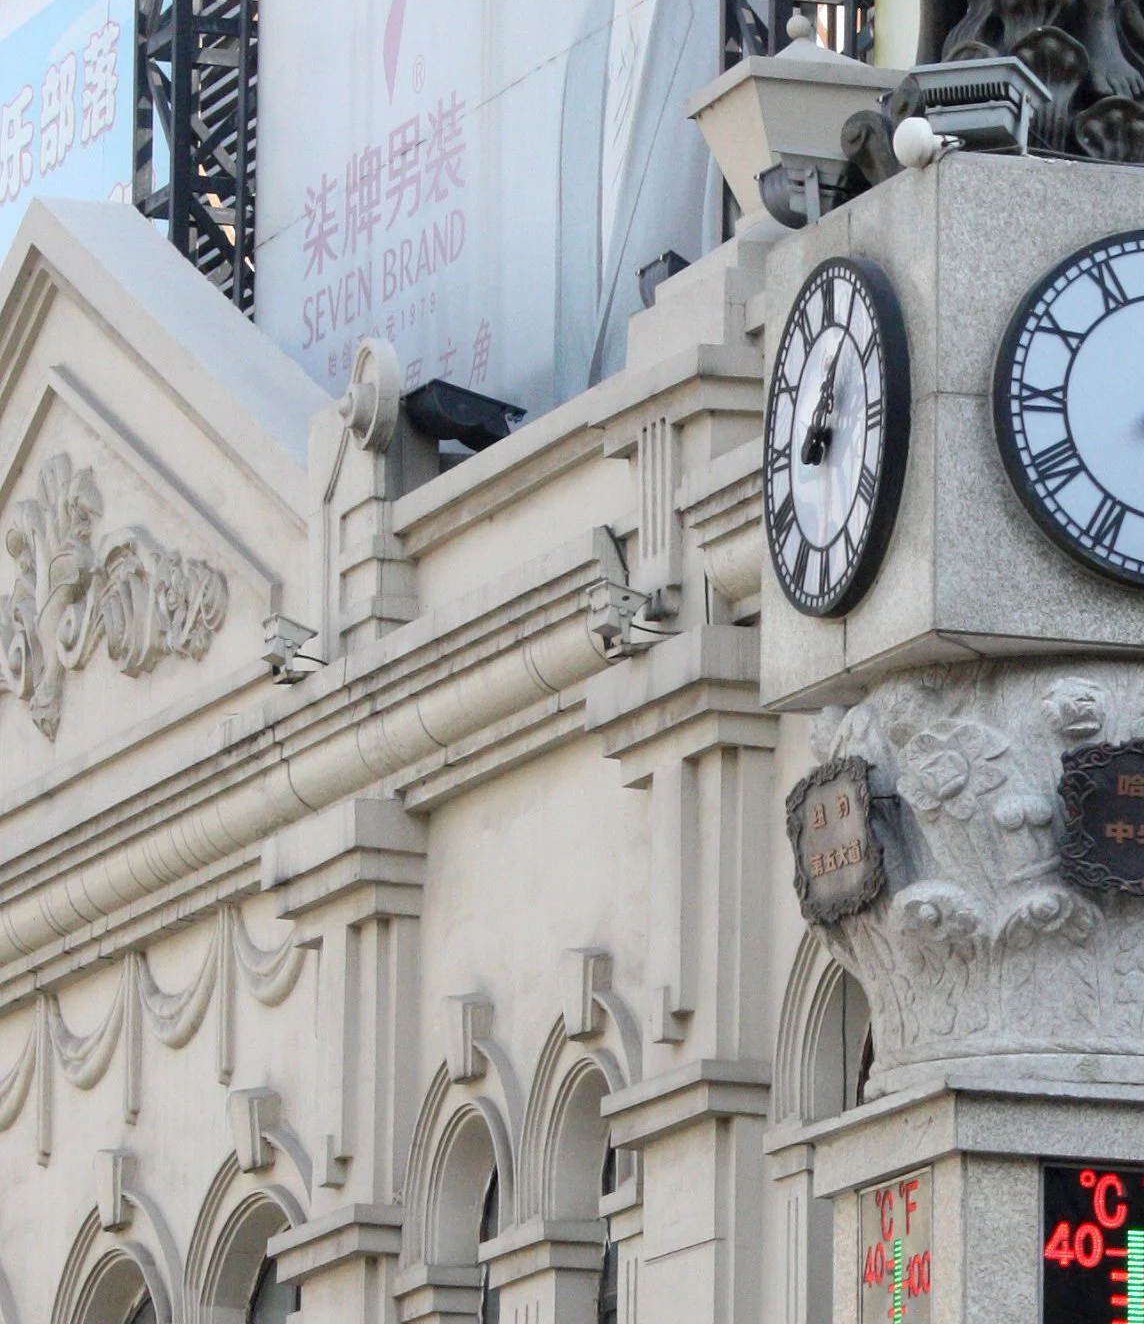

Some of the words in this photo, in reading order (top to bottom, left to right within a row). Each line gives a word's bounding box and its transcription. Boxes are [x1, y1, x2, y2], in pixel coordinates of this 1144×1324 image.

[303, 90, 467, 280] 柒牌男装
[302, 260, 373, 350] SEVEN
[382, 208, 467, 302] BRAND
[809, 839, 862, 879] 第五大道
[864, 1242, 885, 1288] 40
[1044, 1221, 1104, 1268] 40
[906, 1251, 931, 1298] 100
